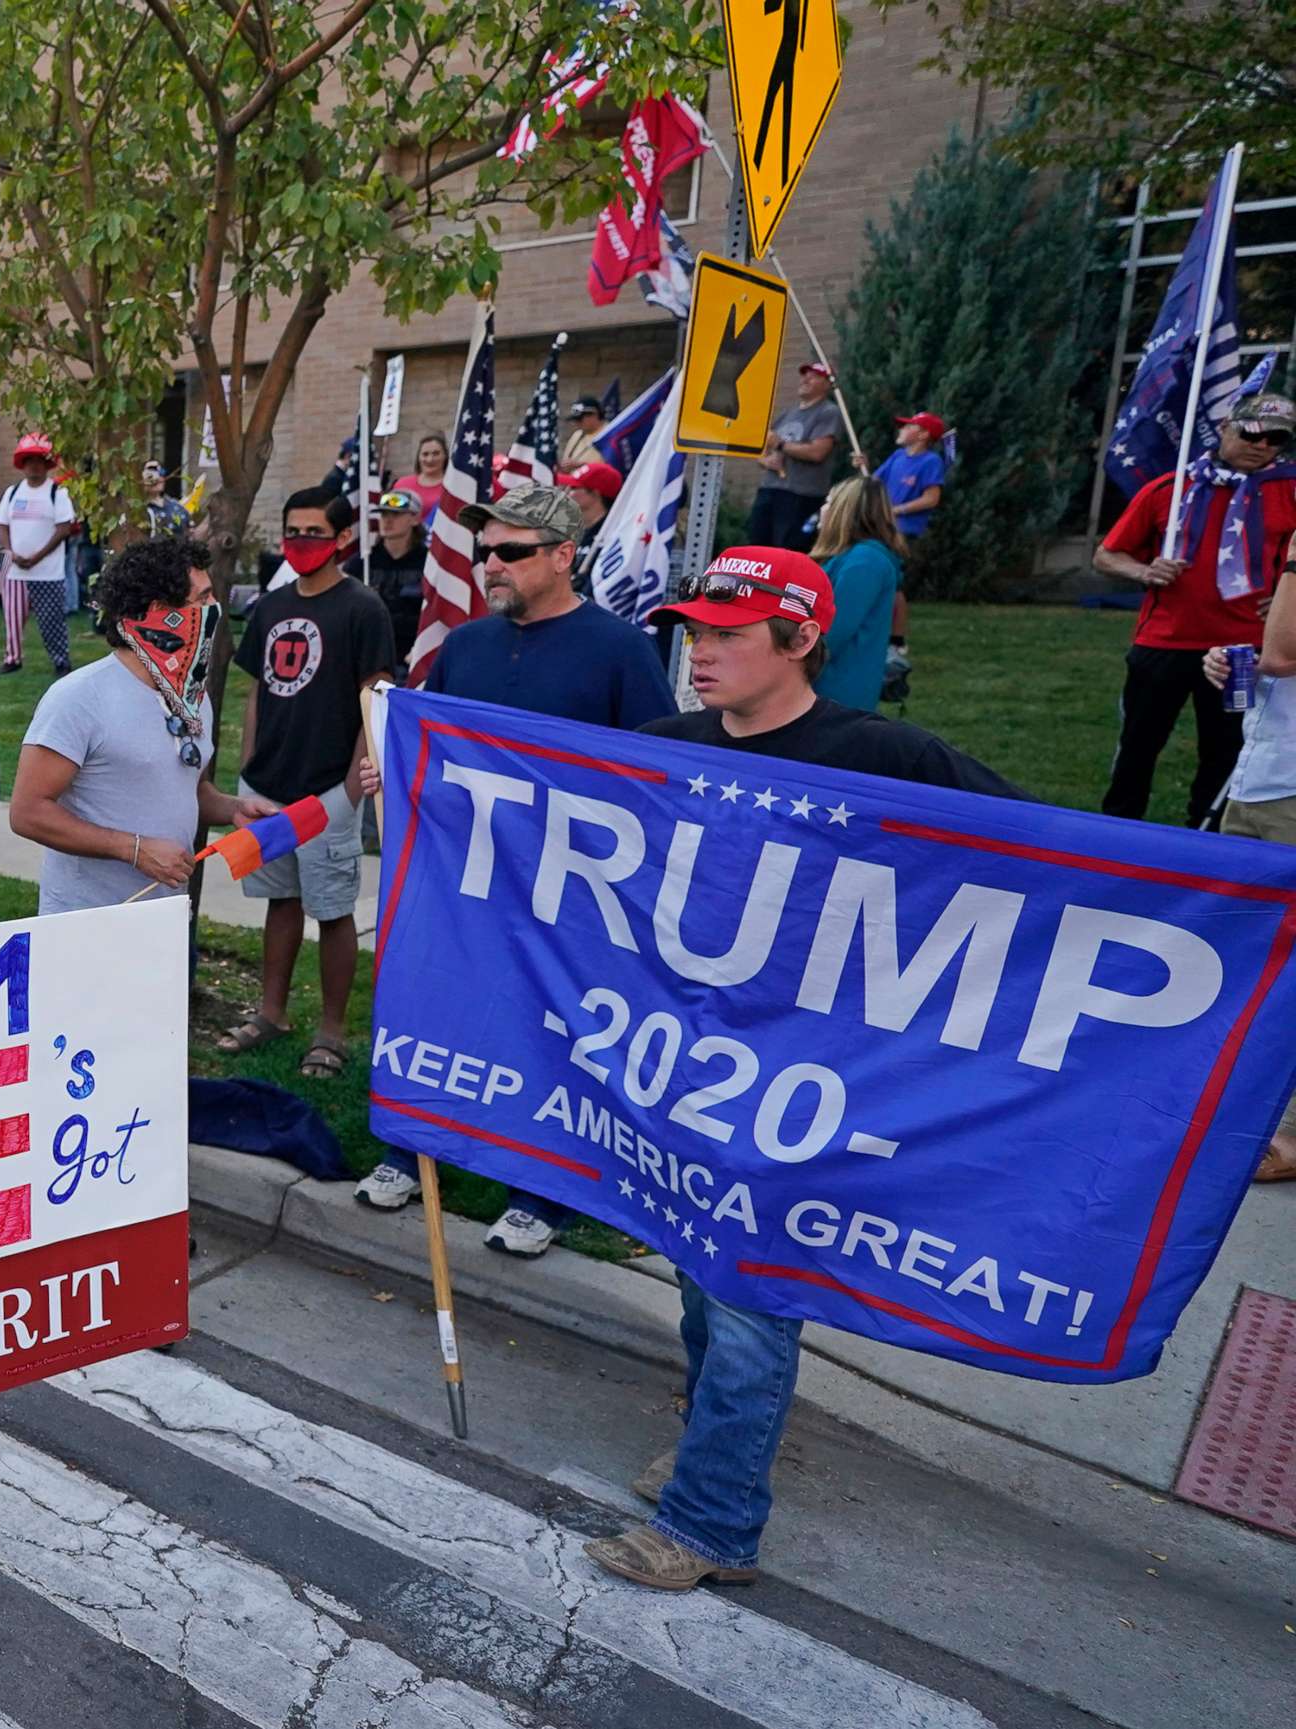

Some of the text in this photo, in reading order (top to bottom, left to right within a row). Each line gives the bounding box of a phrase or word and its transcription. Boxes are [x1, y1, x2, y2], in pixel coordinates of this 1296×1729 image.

[707, 557, 773, 580] AMERICA
[270, 620, 319, 641] UTAH
[274, 639, 307, 679] U
[442, 759, 1223, 1072] TRUMP
[544, 987, 900, 1164] -2020-
[46, 1106, 152, 1206] got
[372, 1026, 1094, 1337] KEEP AMERICA GREAT!
